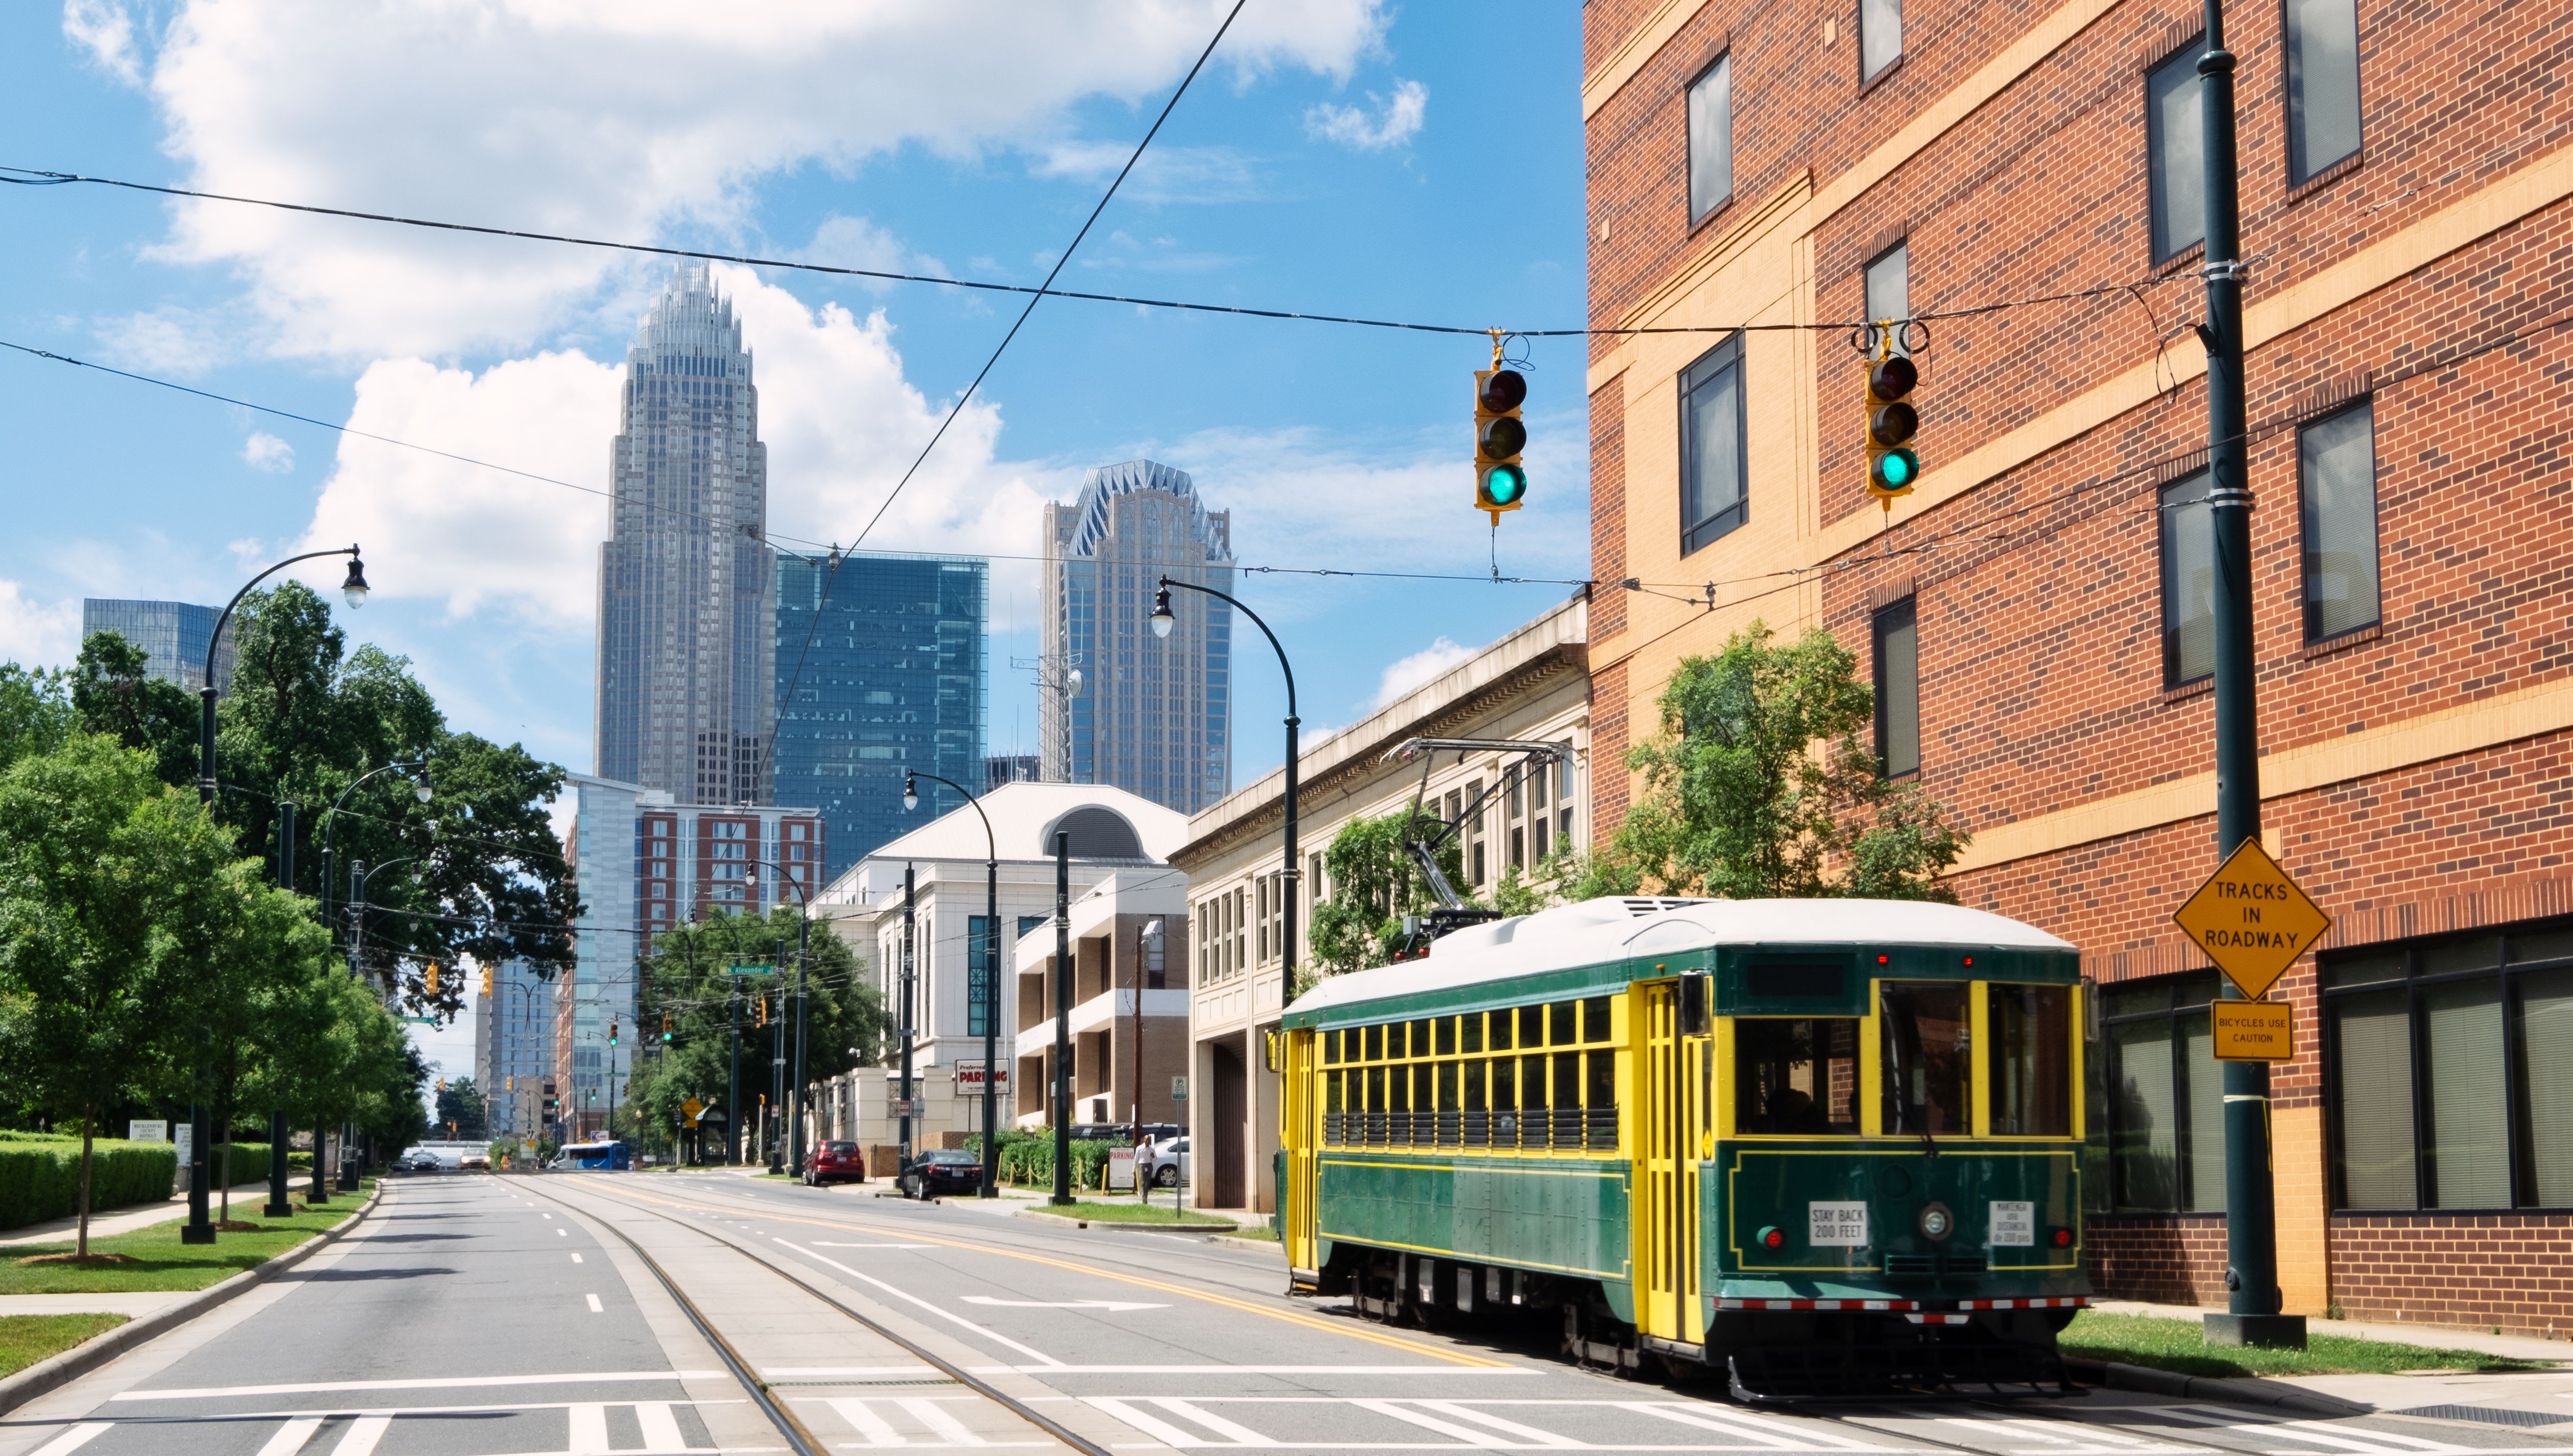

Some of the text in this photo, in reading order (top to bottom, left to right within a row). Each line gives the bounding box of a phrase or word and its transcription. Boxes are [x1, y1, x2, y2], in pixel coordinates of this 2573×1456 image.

[2216, 882, 2287, 900] TRACKS
[2243, 907, 2260, 923] IN
[2206, 930, 2298, 948] ROADWAY
[2219, 1018, 2286, 1027] BICYCLES USE
[2233, 1034, 2272, 1042] CAUTION
[960, 1071, 1007, 1082] PARNG
[1813, 1210, 1863, 1222] STAY BACK
[1815, 1225, 1861, 1237] 200 FEET
